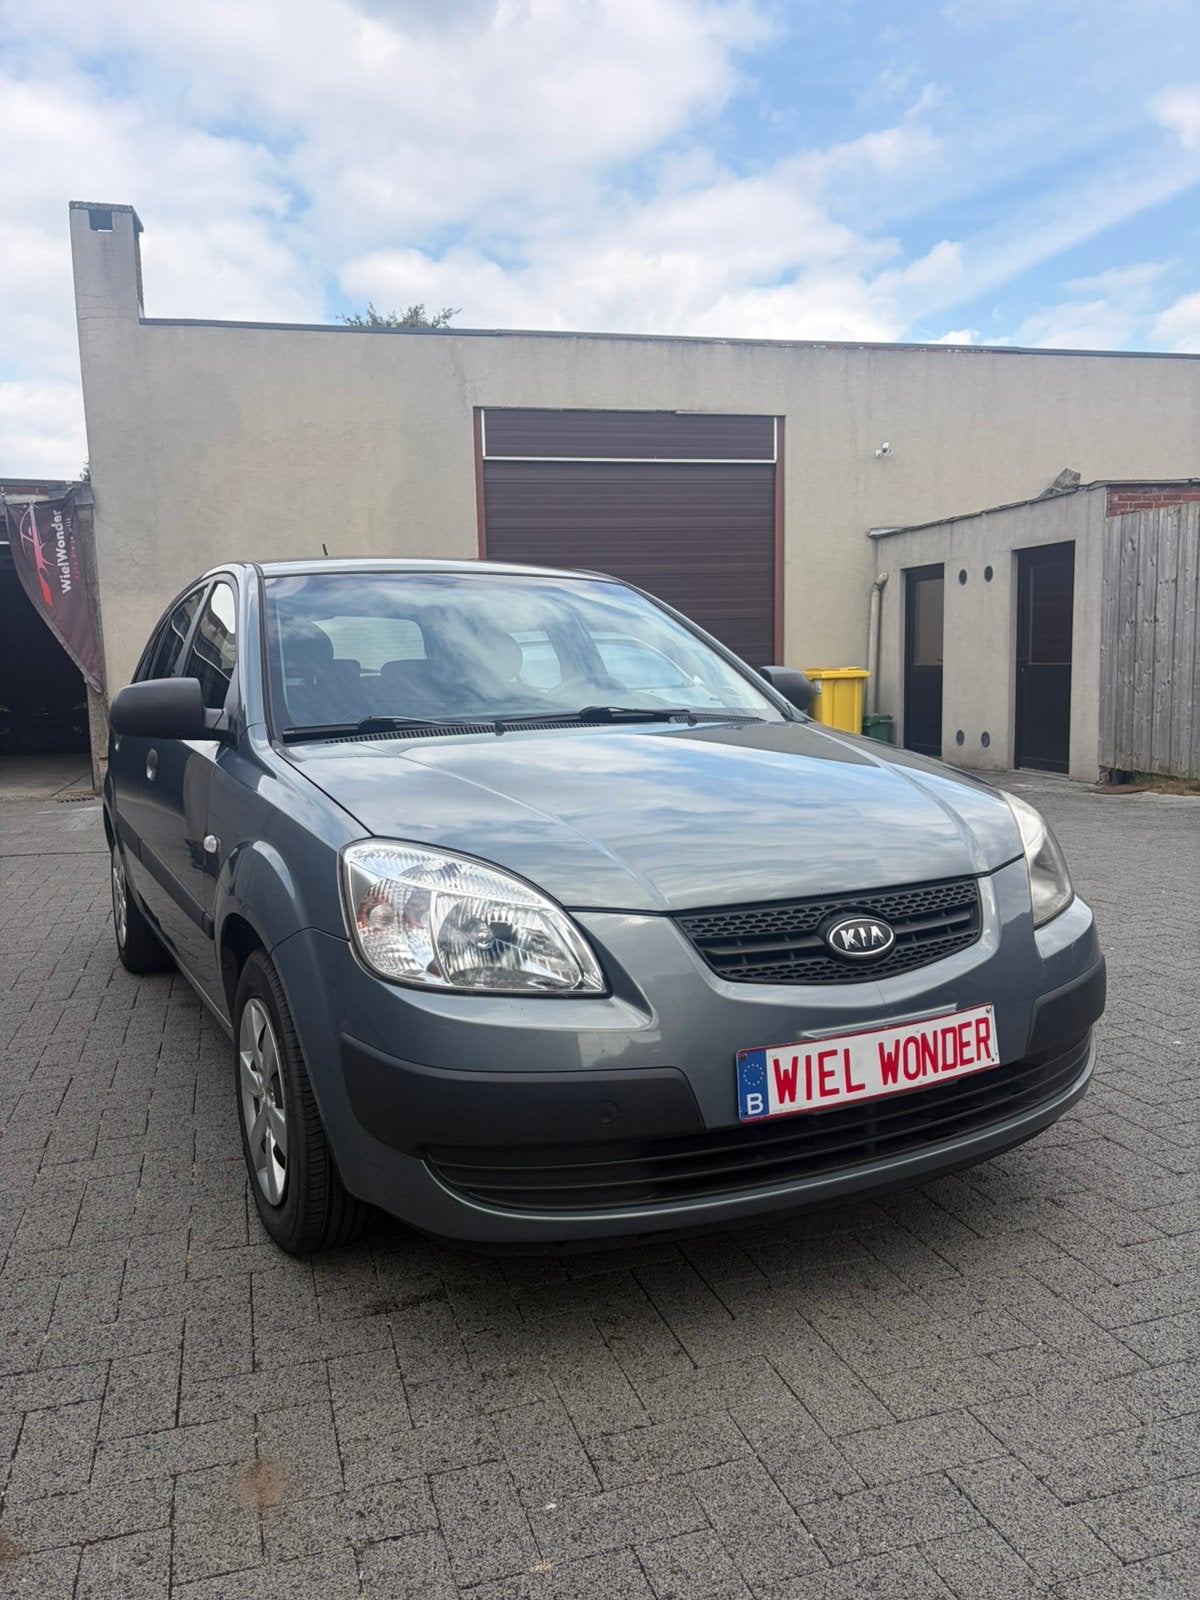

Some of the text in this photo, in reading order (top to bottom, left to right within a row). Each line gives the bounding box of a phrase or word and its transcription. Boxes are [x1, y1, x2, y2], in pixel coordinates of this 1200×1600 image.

[52, 510, 72, 594] WielWonder
[840, 925, 887, 950] KIA
[773, 1017, 992, 1104] WIEL WONDER
[746, 1093, 764, 1115] B
